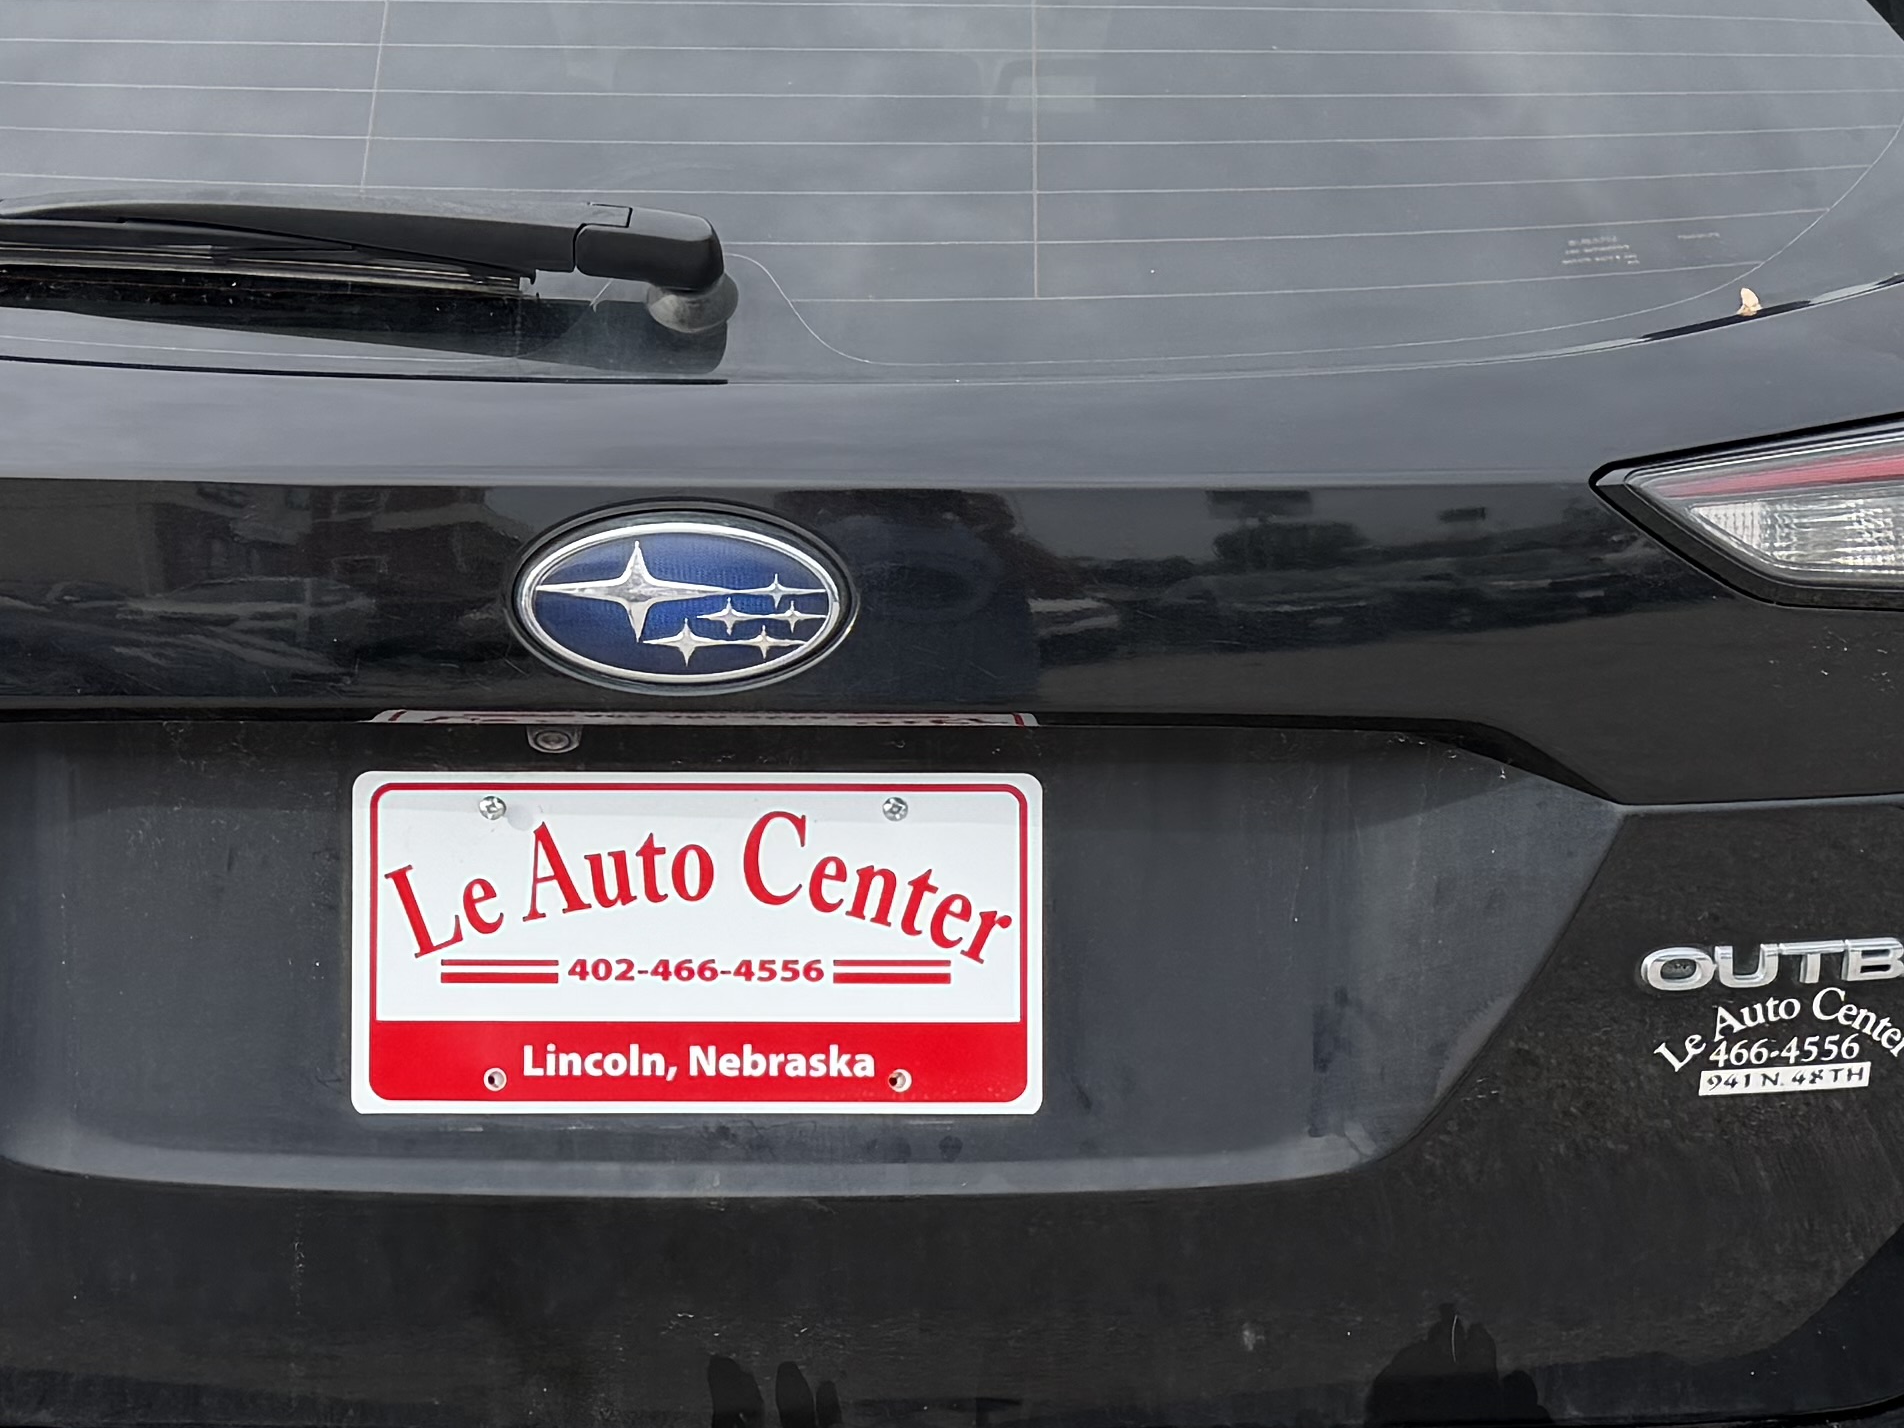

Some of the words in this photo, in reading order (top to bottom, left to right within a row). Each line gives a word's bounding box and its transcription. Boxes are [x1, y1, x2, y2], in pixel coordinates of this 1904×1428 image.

[385, 864, 501, 959] Le
[522, 821, 713, 922] Auto
[743, 810, 1013, 965] Center
[567, 958, 825, 983] 402-466-4556
[1653, 1033, 1707, 1072] Le
[1713, 998, 1801, 1042] Auto
[1708, 1032, 1860, 1068] 466-4556
[523, 1045, 678, 1082] Lincoln,
[689, 1044, 876, 1079] Nebraska
[1706, 1073, 1751, 1092] 941
[1791, 1066, 1865, 1085] 48TH
